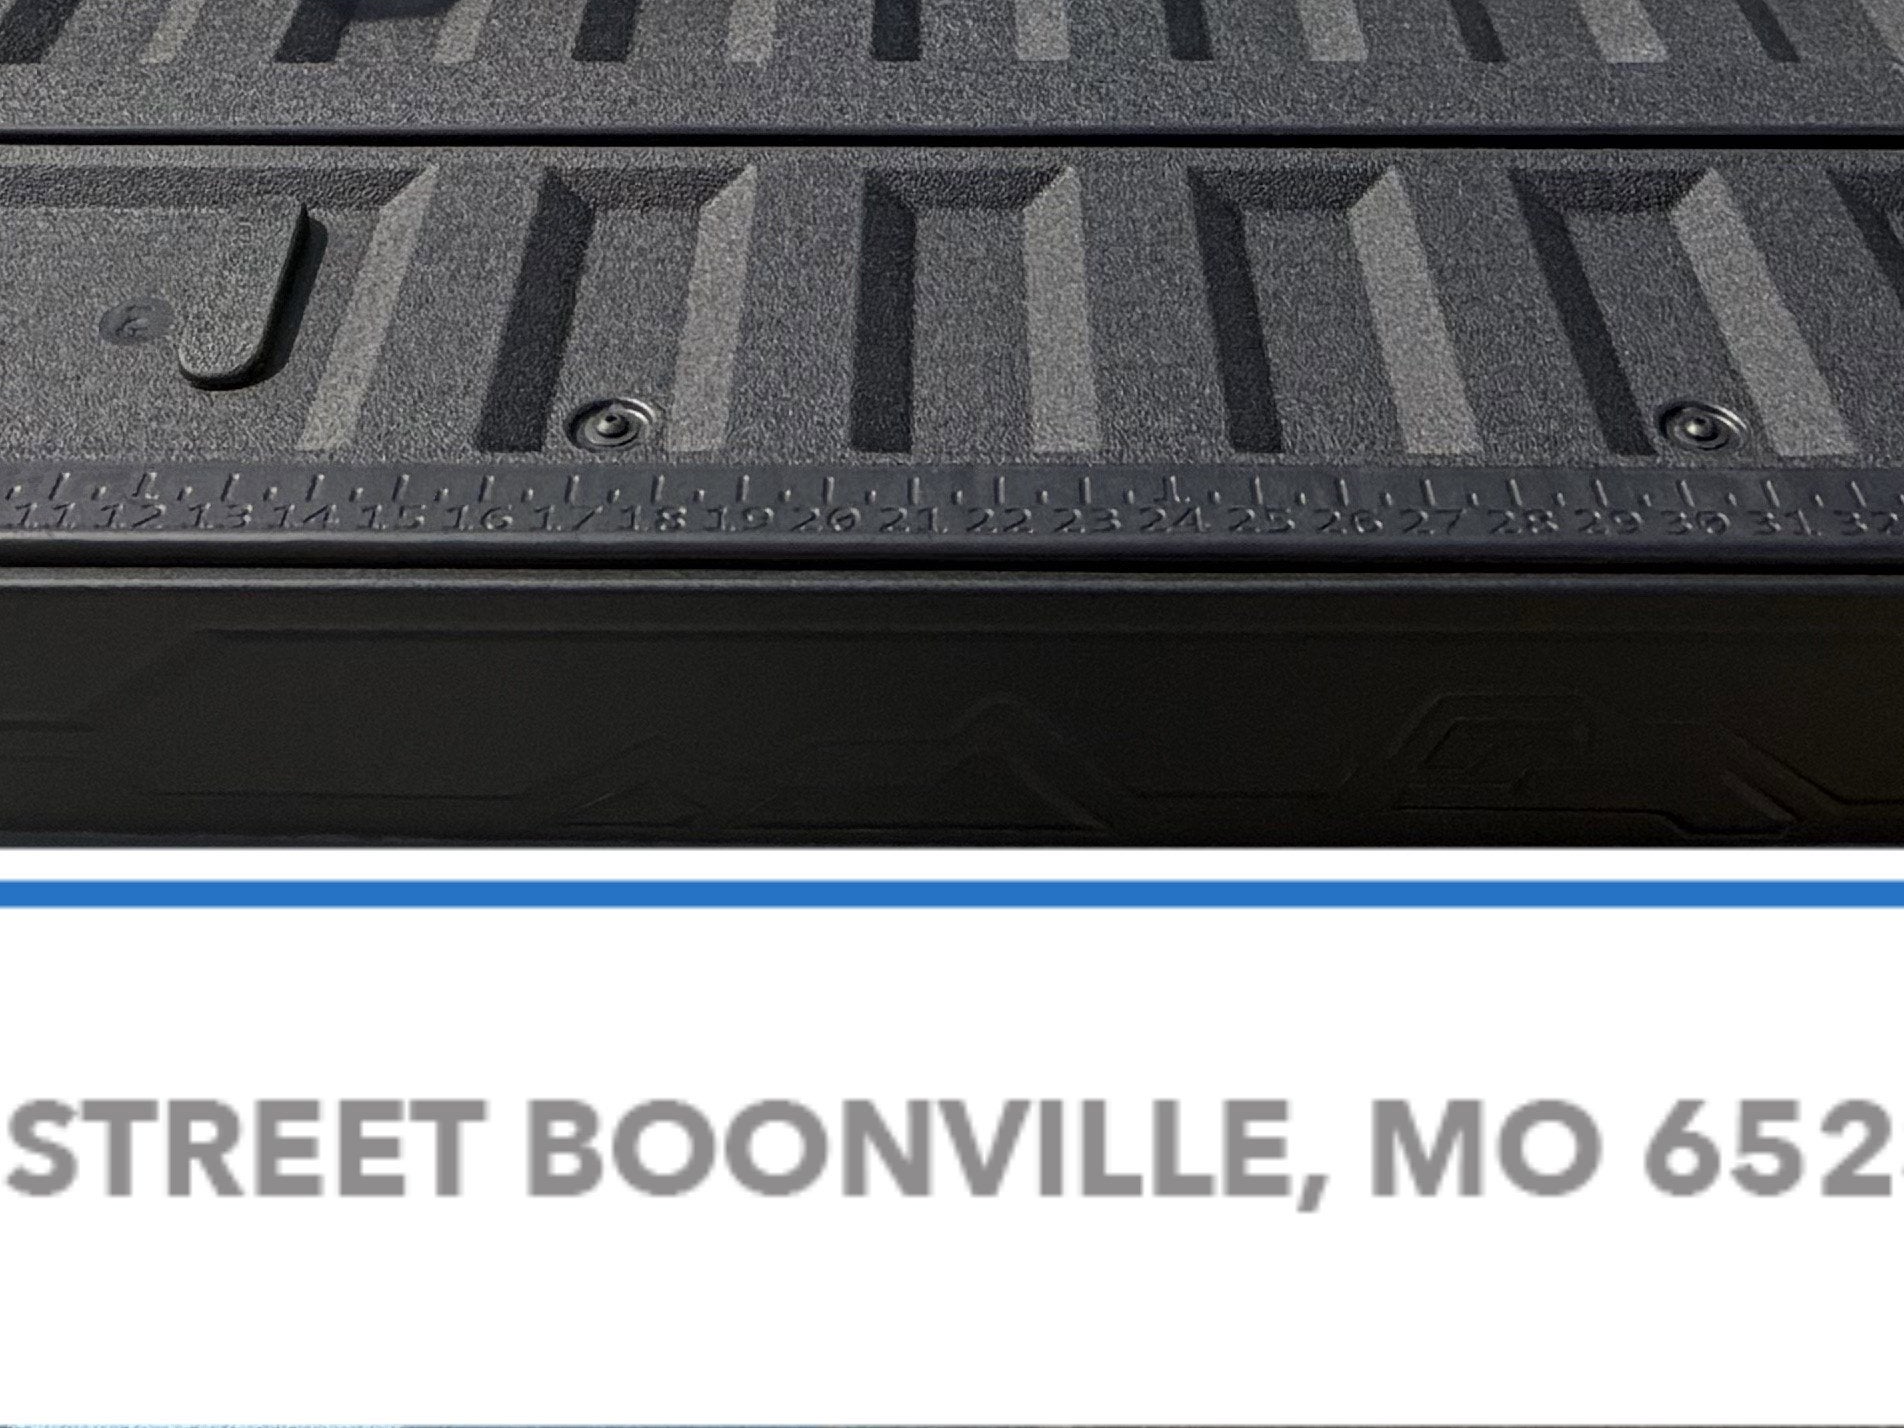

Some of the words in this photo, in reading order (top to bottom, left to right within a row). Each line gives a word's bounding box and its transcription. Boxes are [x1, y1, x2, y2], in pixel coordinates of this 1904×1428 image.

[14, 503, 76, 529] 11
[100, 503, 166, 529] 12
[187, 504, 253, 529] 13
[272, 504, 341, 529] 14
[360, 504, 426, 530] 15
[444, 504, 514, 530] 16
[530, 505, 604, 531] 17
[618, 505, 687, 531] 18
[703, 506, 775, 532] 19
[790, 506, 860, 532] 20
[877, 506, 948, 532] 21
[964, 507, 1034, 532] 22
[1051, 507, 1121, 532] 23
[1138, 507, 1210, 532] 24
[1227, 507, 1296, 533] 25
[1312, 508, 1383, 534] 26
[1399, 508, 1467, 534] 27
[1486, 508, 1559, 534] 28
[1573, 508, 1641, 535] 29
[1660, 509, 1731, 535] 30
[1746, 510, 1821, 535] 31
